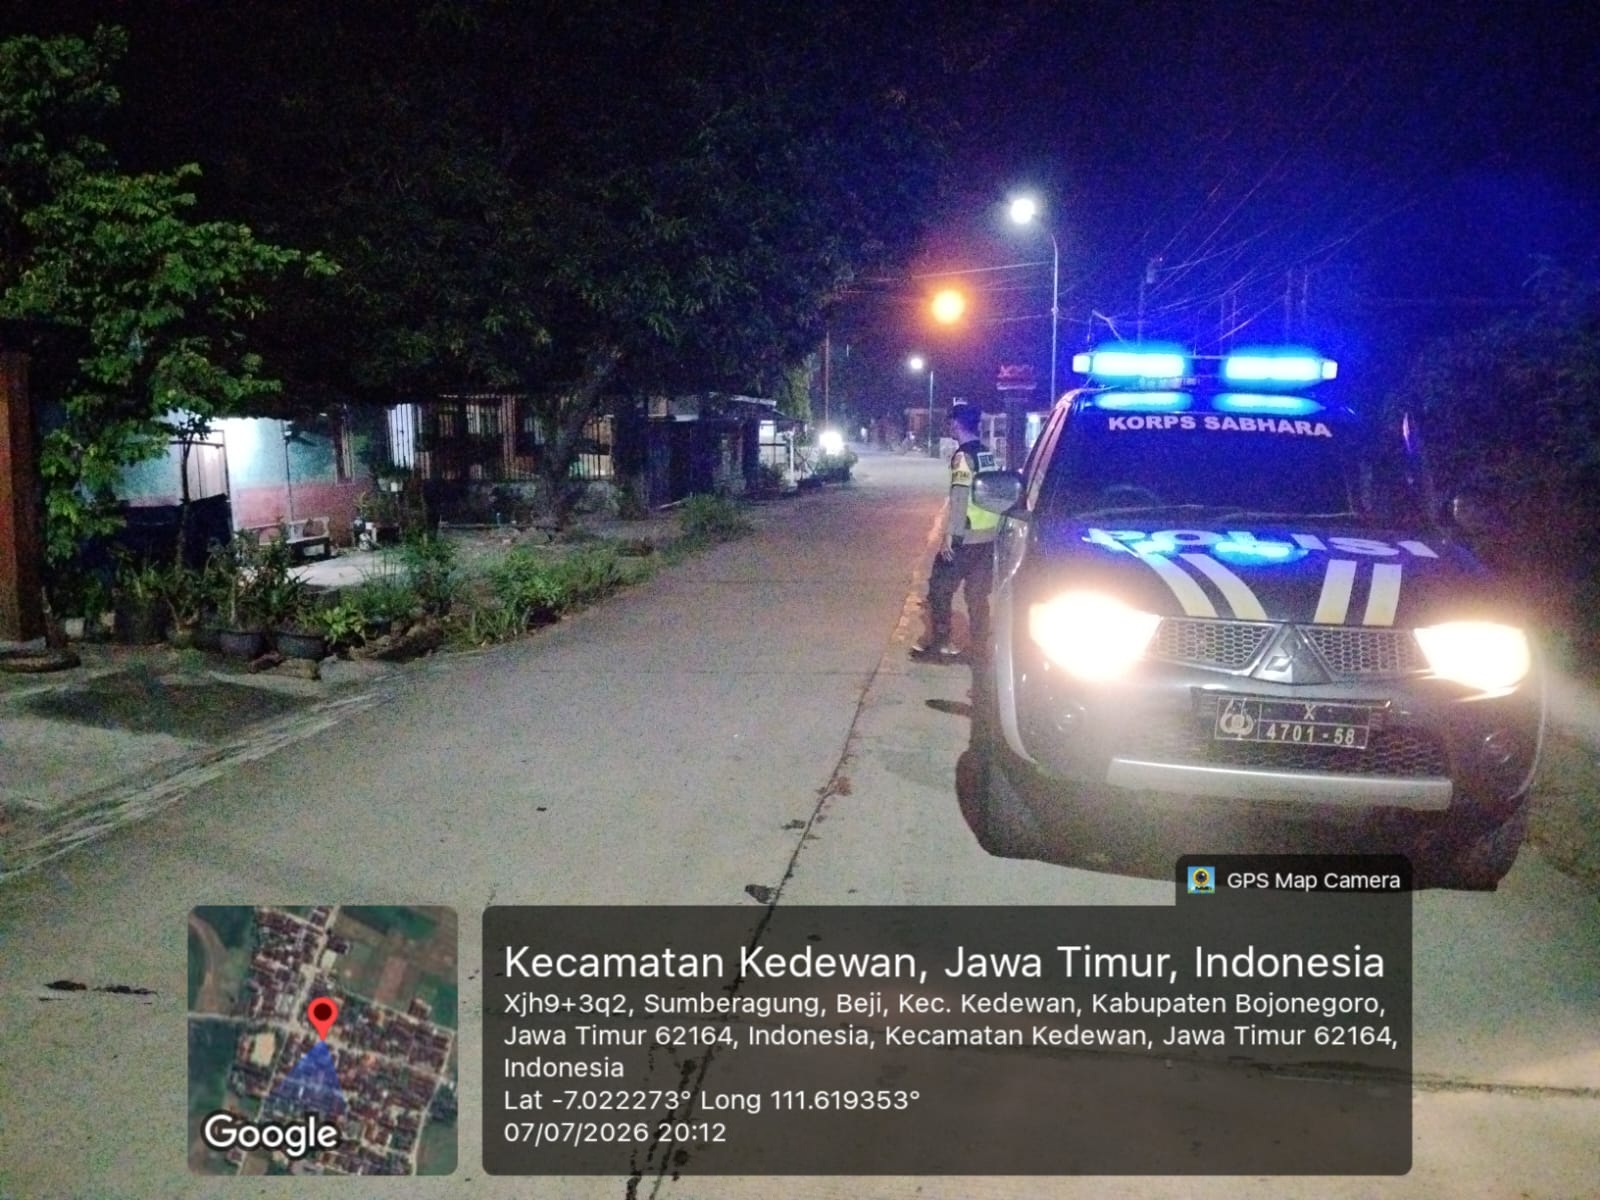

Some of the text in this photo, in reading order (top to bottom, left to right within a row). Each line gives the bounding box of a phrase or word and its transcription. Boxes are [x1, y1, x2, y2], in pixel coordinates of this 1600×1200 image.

[1109, 416, 1332, 437] KORPS SABHARA
[1082, 528, 1438, 559] POLISI
[1304, 704, 1315, 721] X
